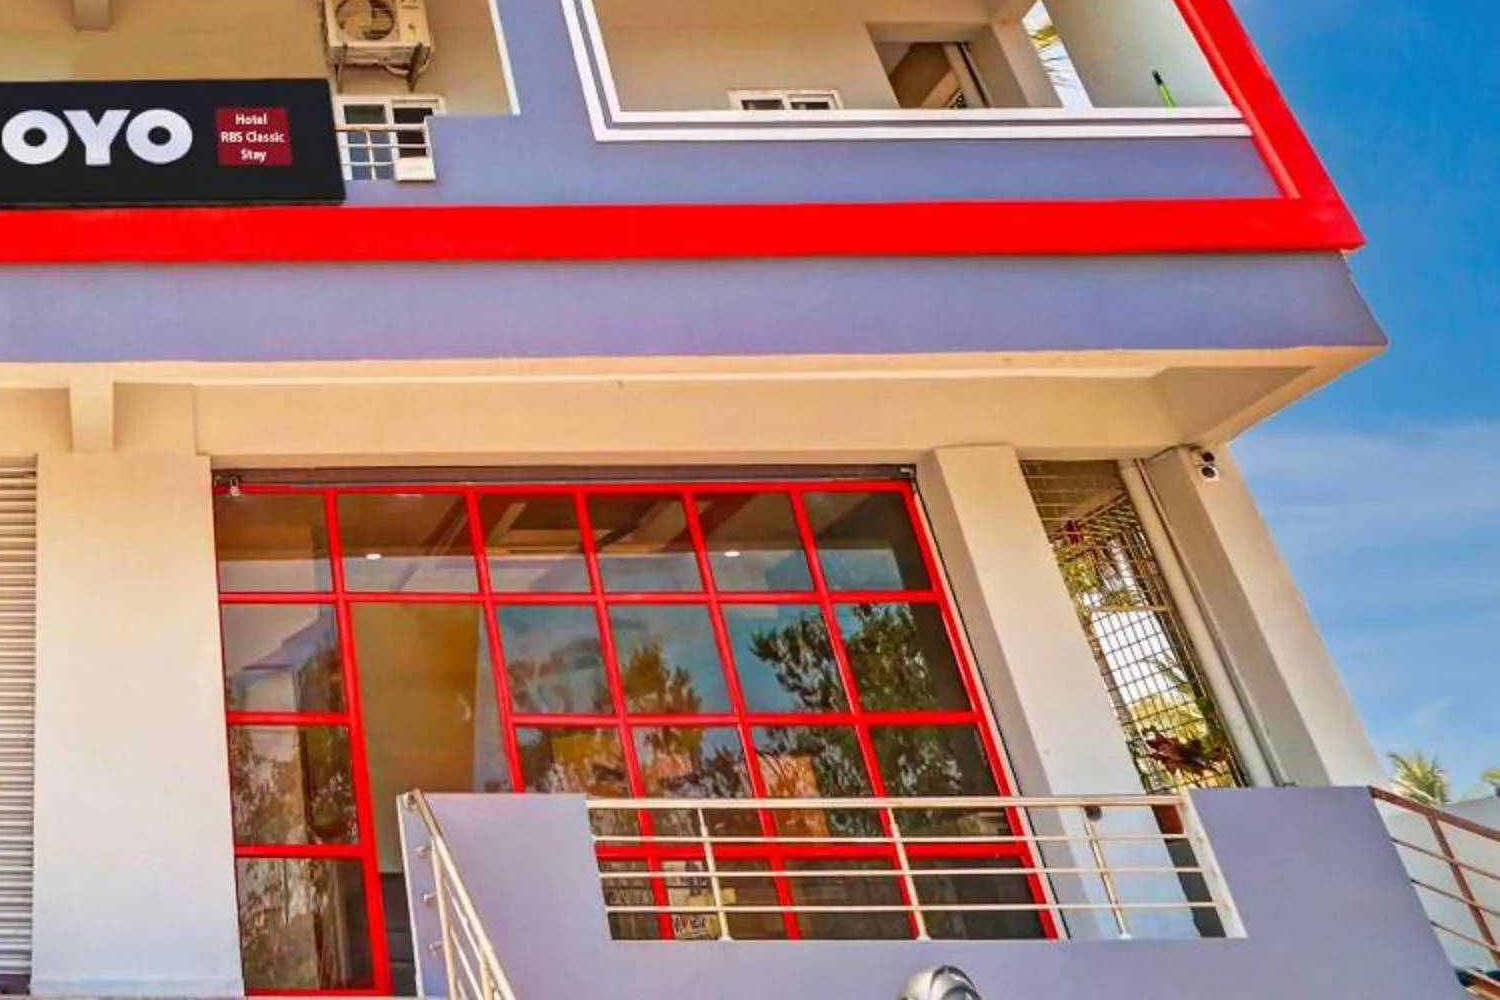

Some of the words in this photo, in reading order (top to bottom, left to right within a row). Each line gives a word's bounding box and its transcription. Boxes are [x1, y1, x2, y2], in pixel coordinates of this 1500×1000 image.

[235, 113, 268, 125] Hotel
[2, 109, 193, 166] OYO
[221, 131, 243, 143] RBS
[245, 130, 285, 143] Classic
[240, 147, 267, 163] Stay
